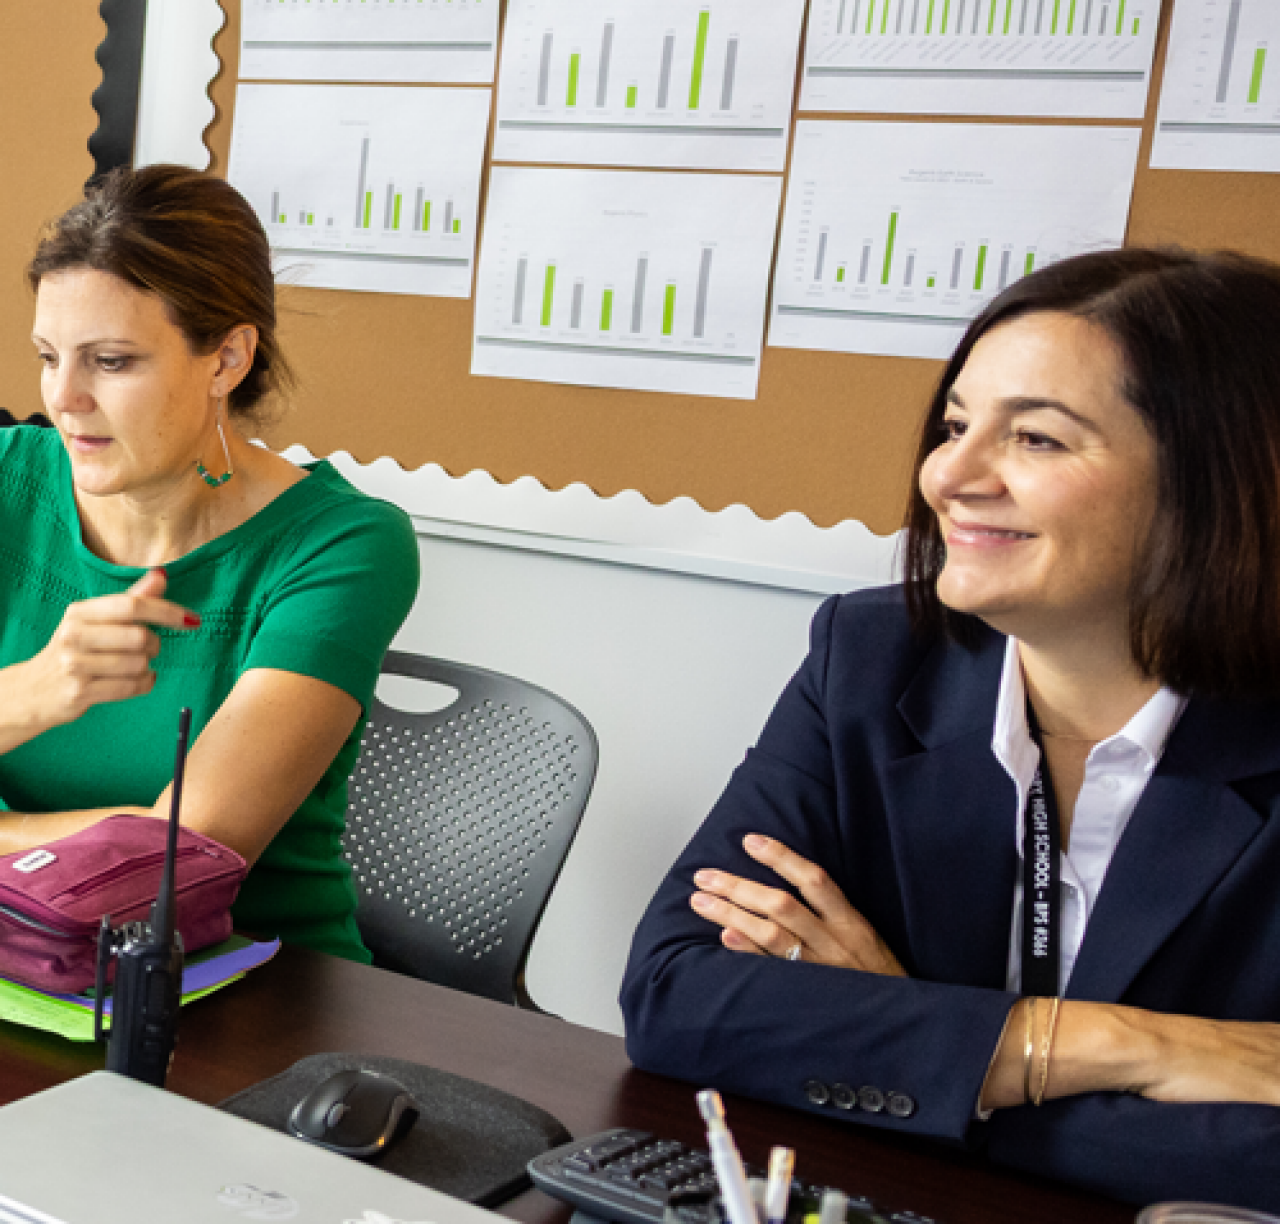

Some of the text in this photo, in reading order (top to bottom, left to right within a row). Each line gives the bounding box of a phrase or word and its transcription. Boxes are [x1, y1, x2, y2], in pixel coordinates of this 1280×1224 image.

[1032, 798, 1048, 831] HIGH
[1034, 833, 1051, 889] SCHOOL
[1033, 901, 1050, 925] BPS
